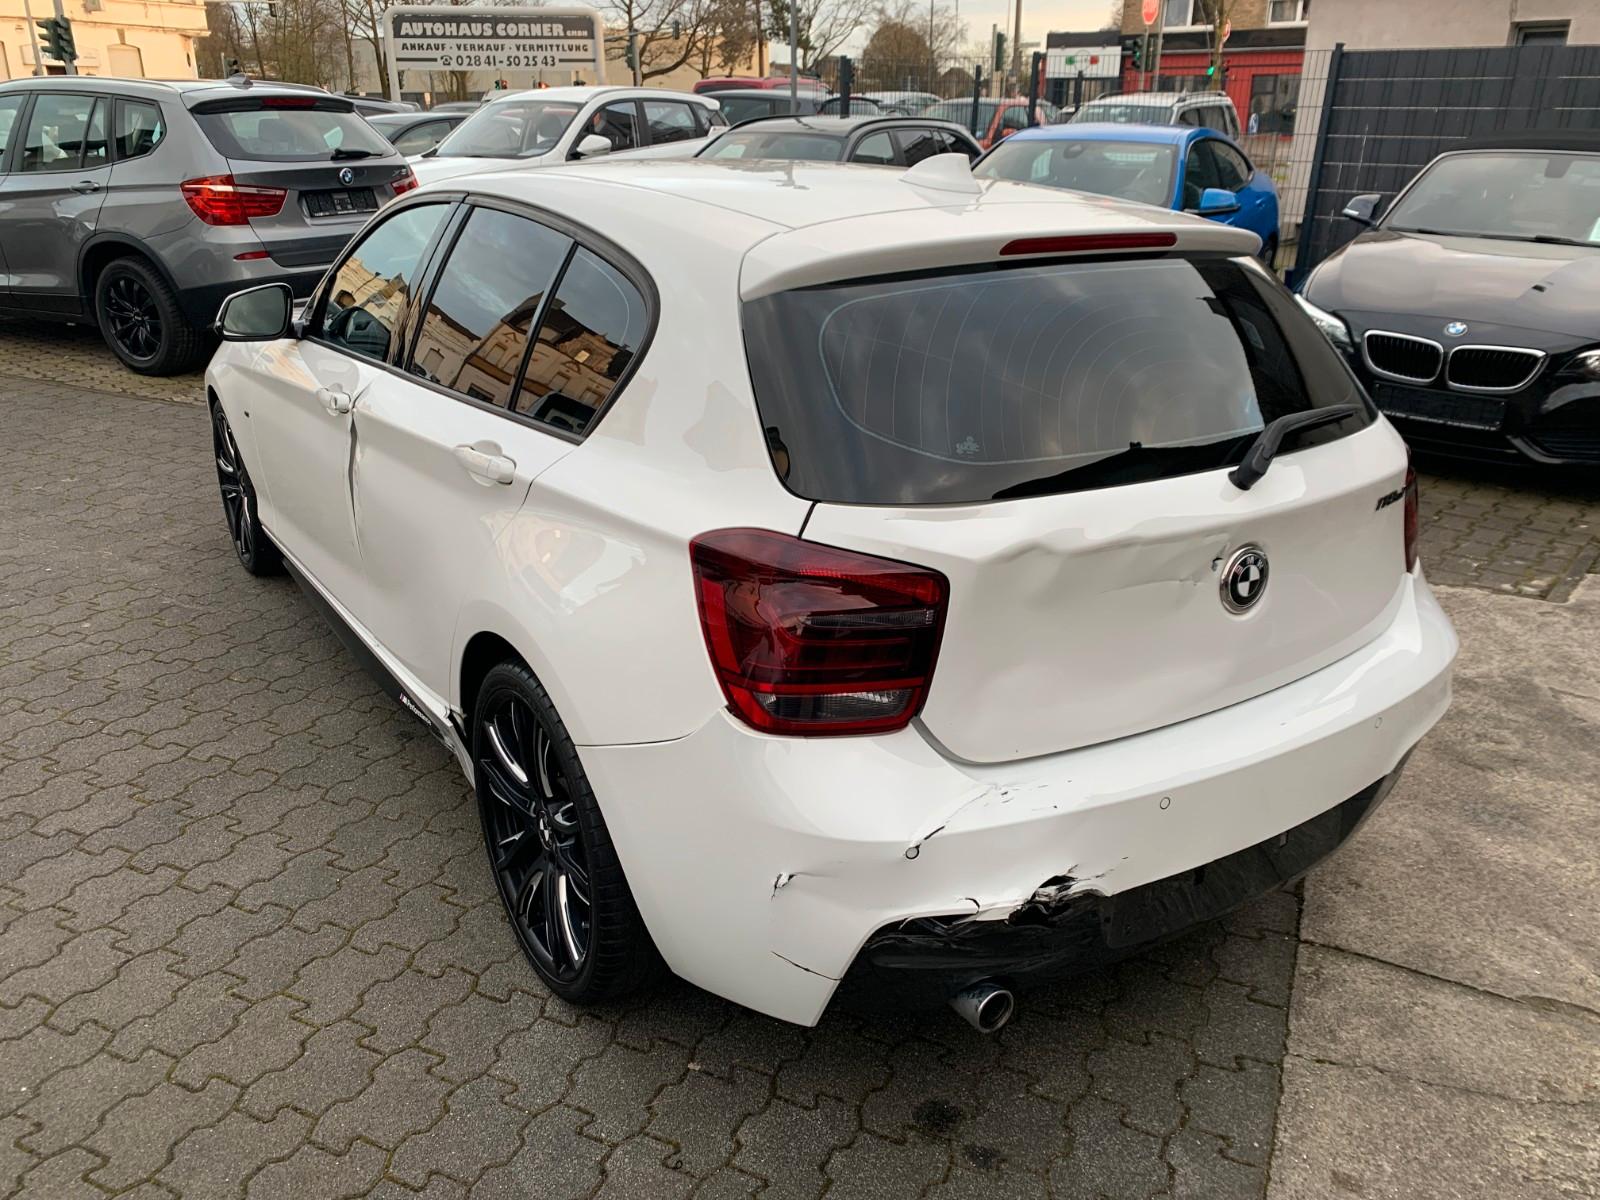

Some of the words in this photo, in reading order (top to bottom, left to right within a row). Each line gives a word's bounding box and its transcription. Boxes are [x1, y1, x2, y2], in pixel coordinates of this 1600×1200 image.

[400, 22, 493, 36] AUTOHAUS
[496, 22, 565, 37] CORNER
[401, 42, 446, 52] ANKAUF
[456, 43, 506, 52] VERKAUF
[515, 43, 589, 52] VERMITTLUNG
